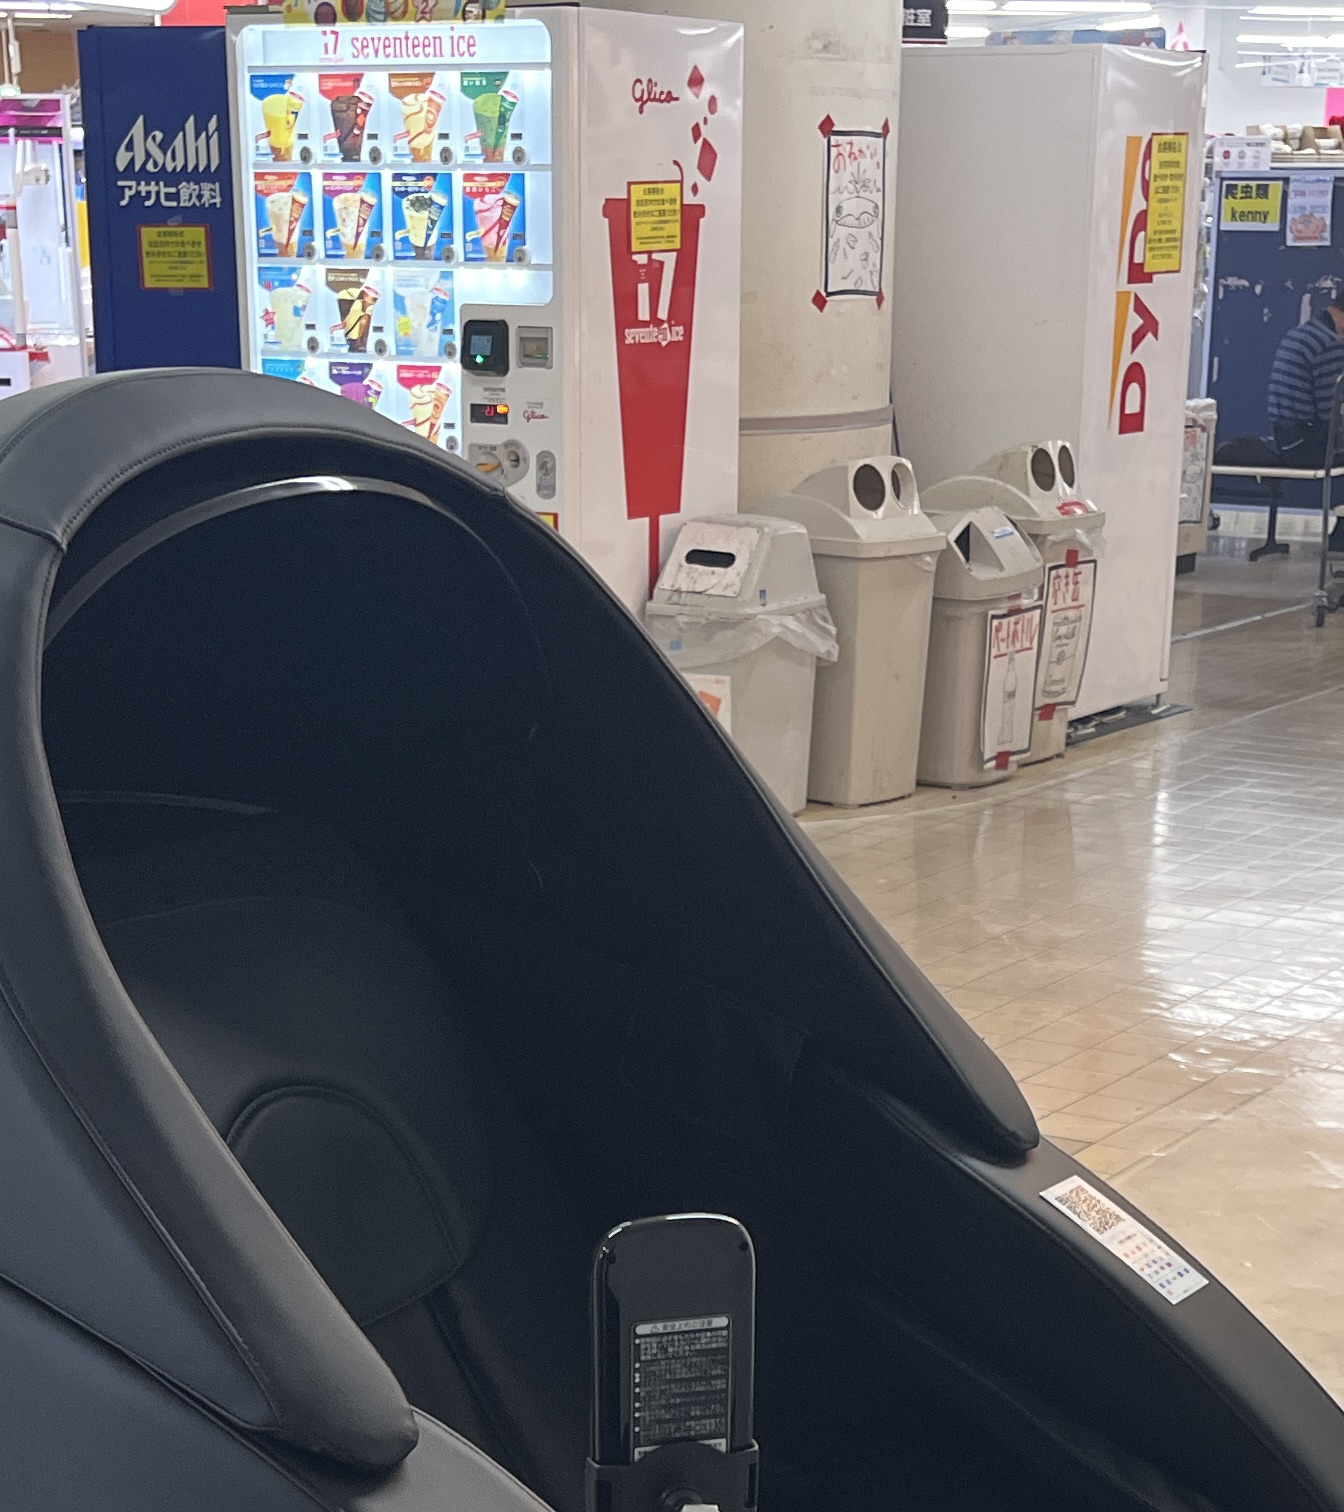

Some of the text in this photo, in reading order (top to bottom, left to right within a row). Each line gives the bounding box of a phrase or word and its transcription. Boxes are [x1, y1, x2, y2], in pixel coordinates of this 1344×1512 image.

[350, 31, 444, 60] seventeen
[449, 26, 477, 58] ice
[631, 78, 680, 115] Glico
[115, 114, 221, 174] Asahi
[116, 181, 222, 208] アサヒ飲料
[1230, 206, 1270, 224] kenny
